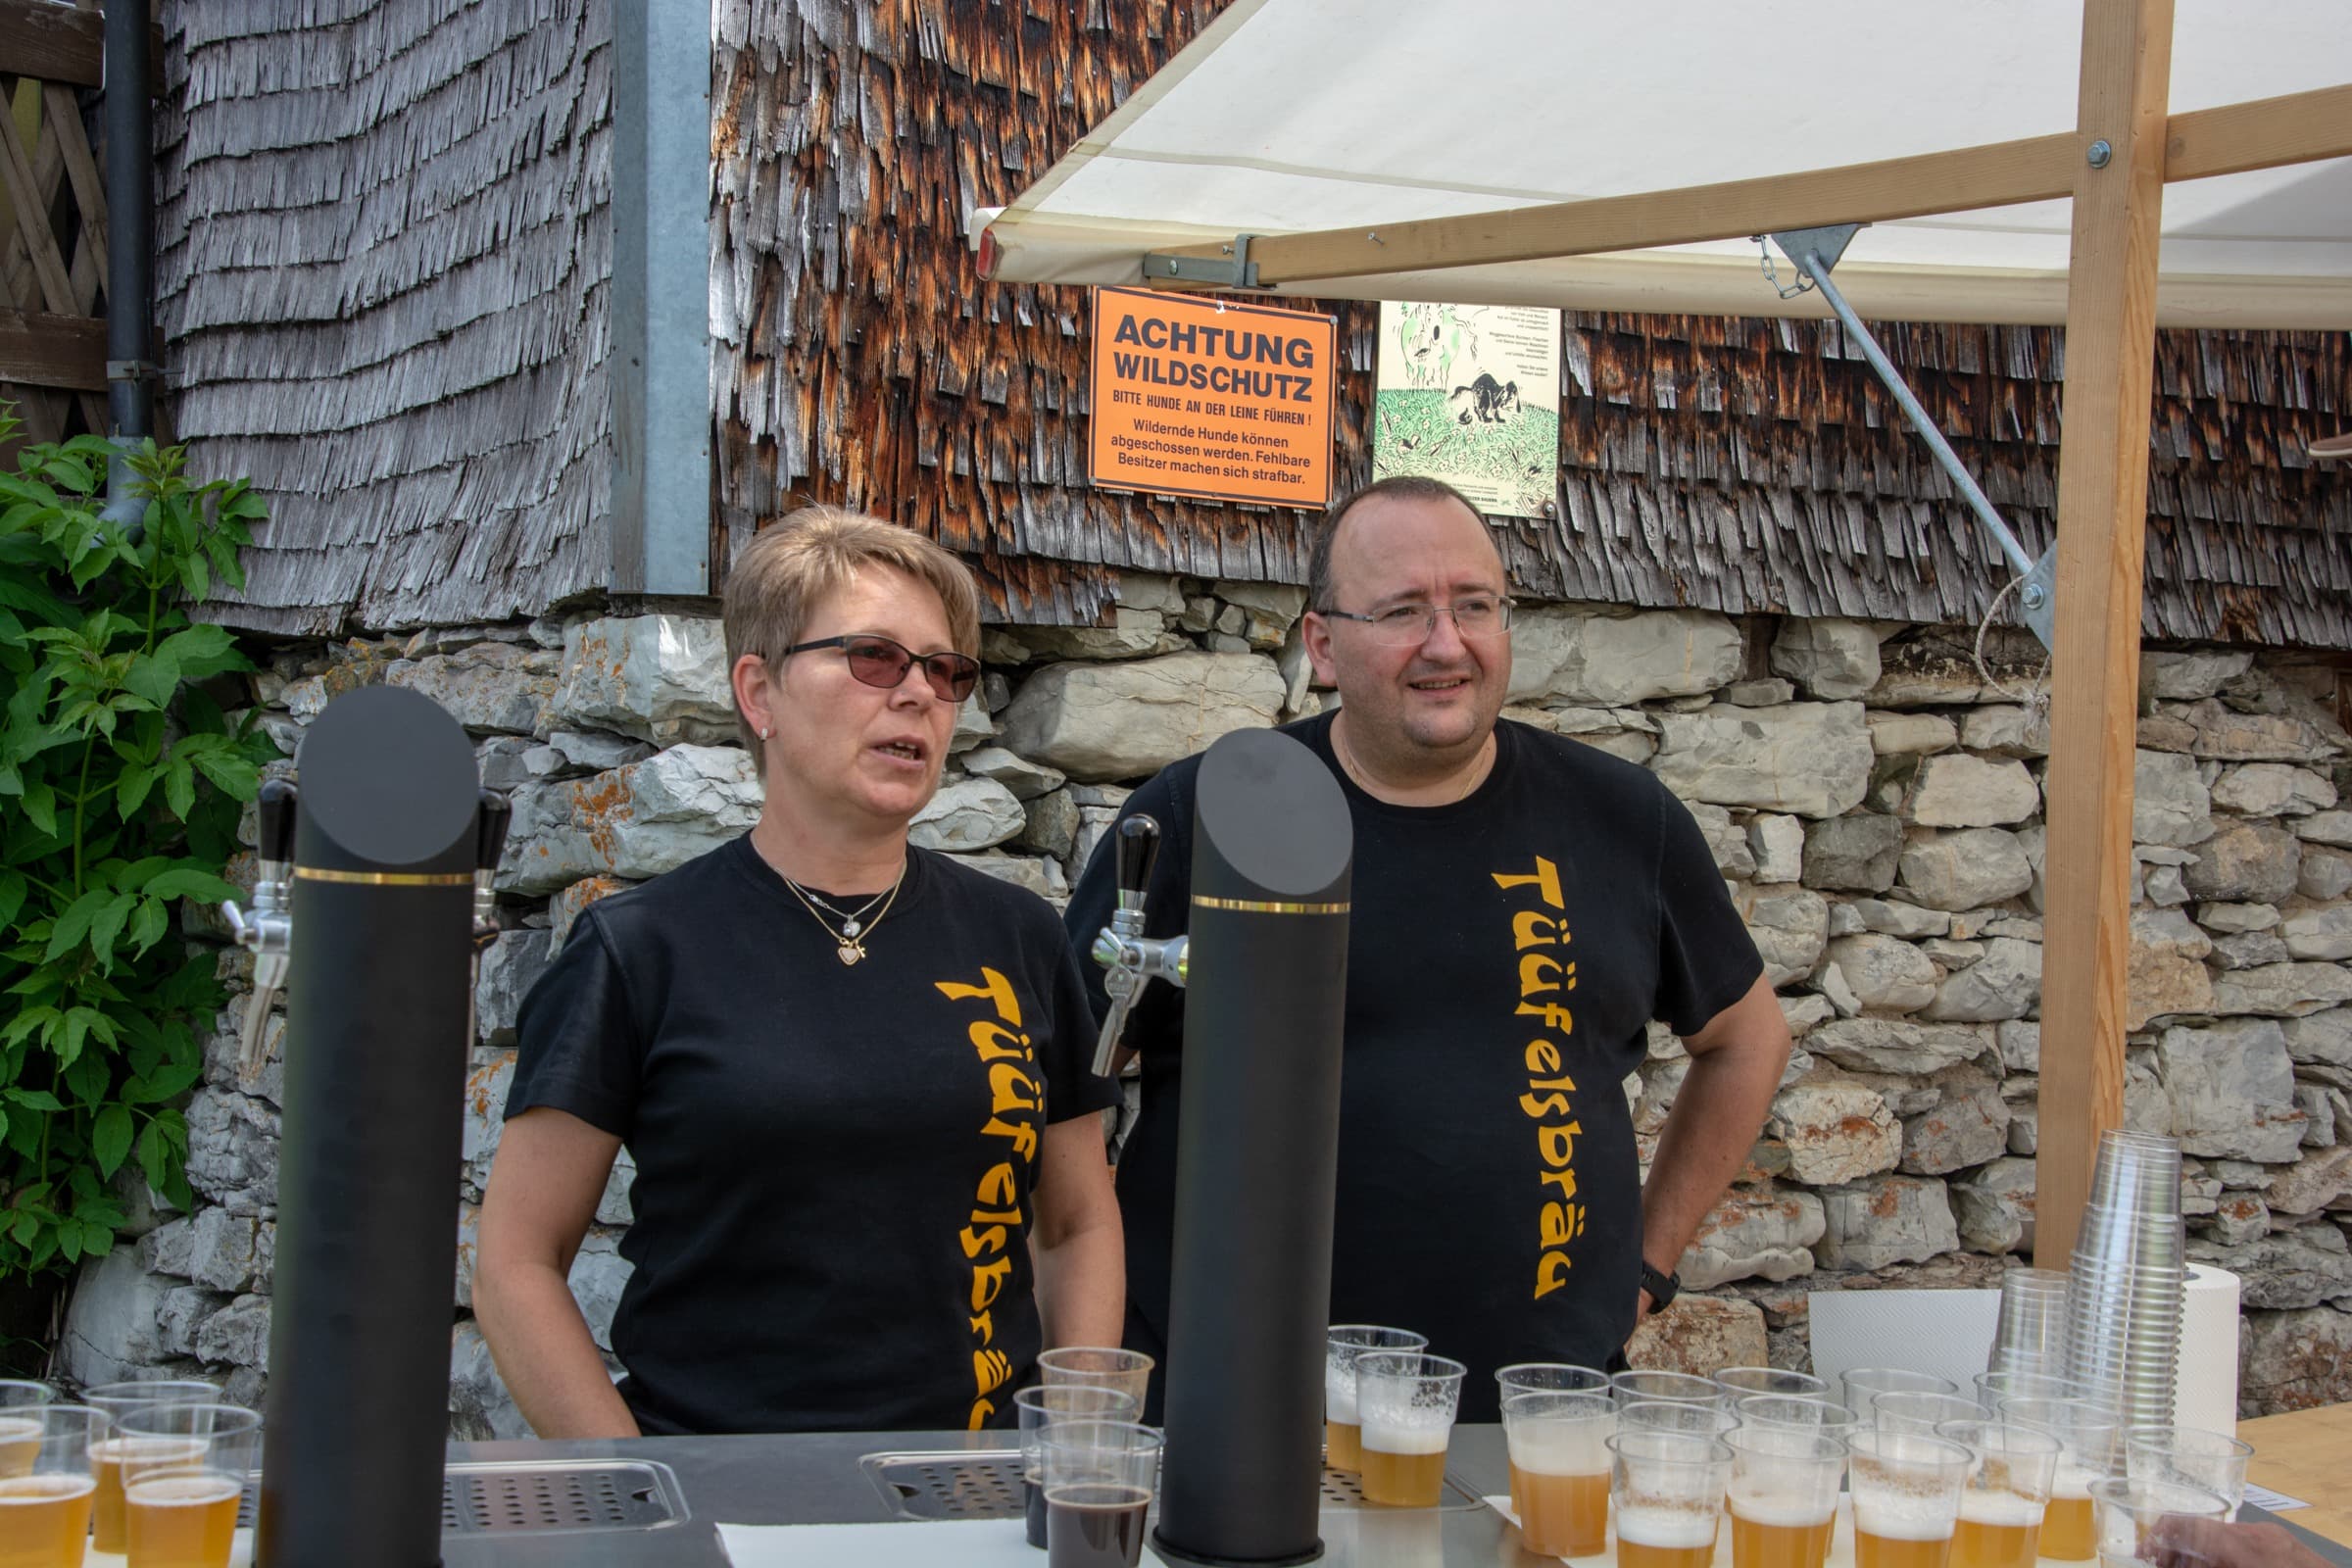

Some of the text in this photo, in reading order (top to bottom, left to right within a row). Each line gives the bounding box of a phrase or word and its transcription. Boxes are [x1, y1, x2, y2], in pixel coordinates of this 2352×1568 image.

[1114, 315, 1313, 368] ACHTUNG
[1113, 352, 1312, 402] WILDSCHUTZ
[1113, 390, 1141, 405] BITTE
[1148, 395, 1180, 410] HUNDE
[1186, 400, 1200, 414] AN
[1206, 403, 1225, 416] DER
[1231, 406, 1258, 419] LEINE
[1264, 410, 1304, 424] FÜHREN
[1134, 419, 1288, 447] Wildernde Hunde können
[1111, 435, 1309, 467] abgeschossen werden. Fehlbare
[1119, 453, 1304, 483] Besitzer machen sich strafbar.
[1492, 855, 1586, 1300] Tüüfelsbräu
